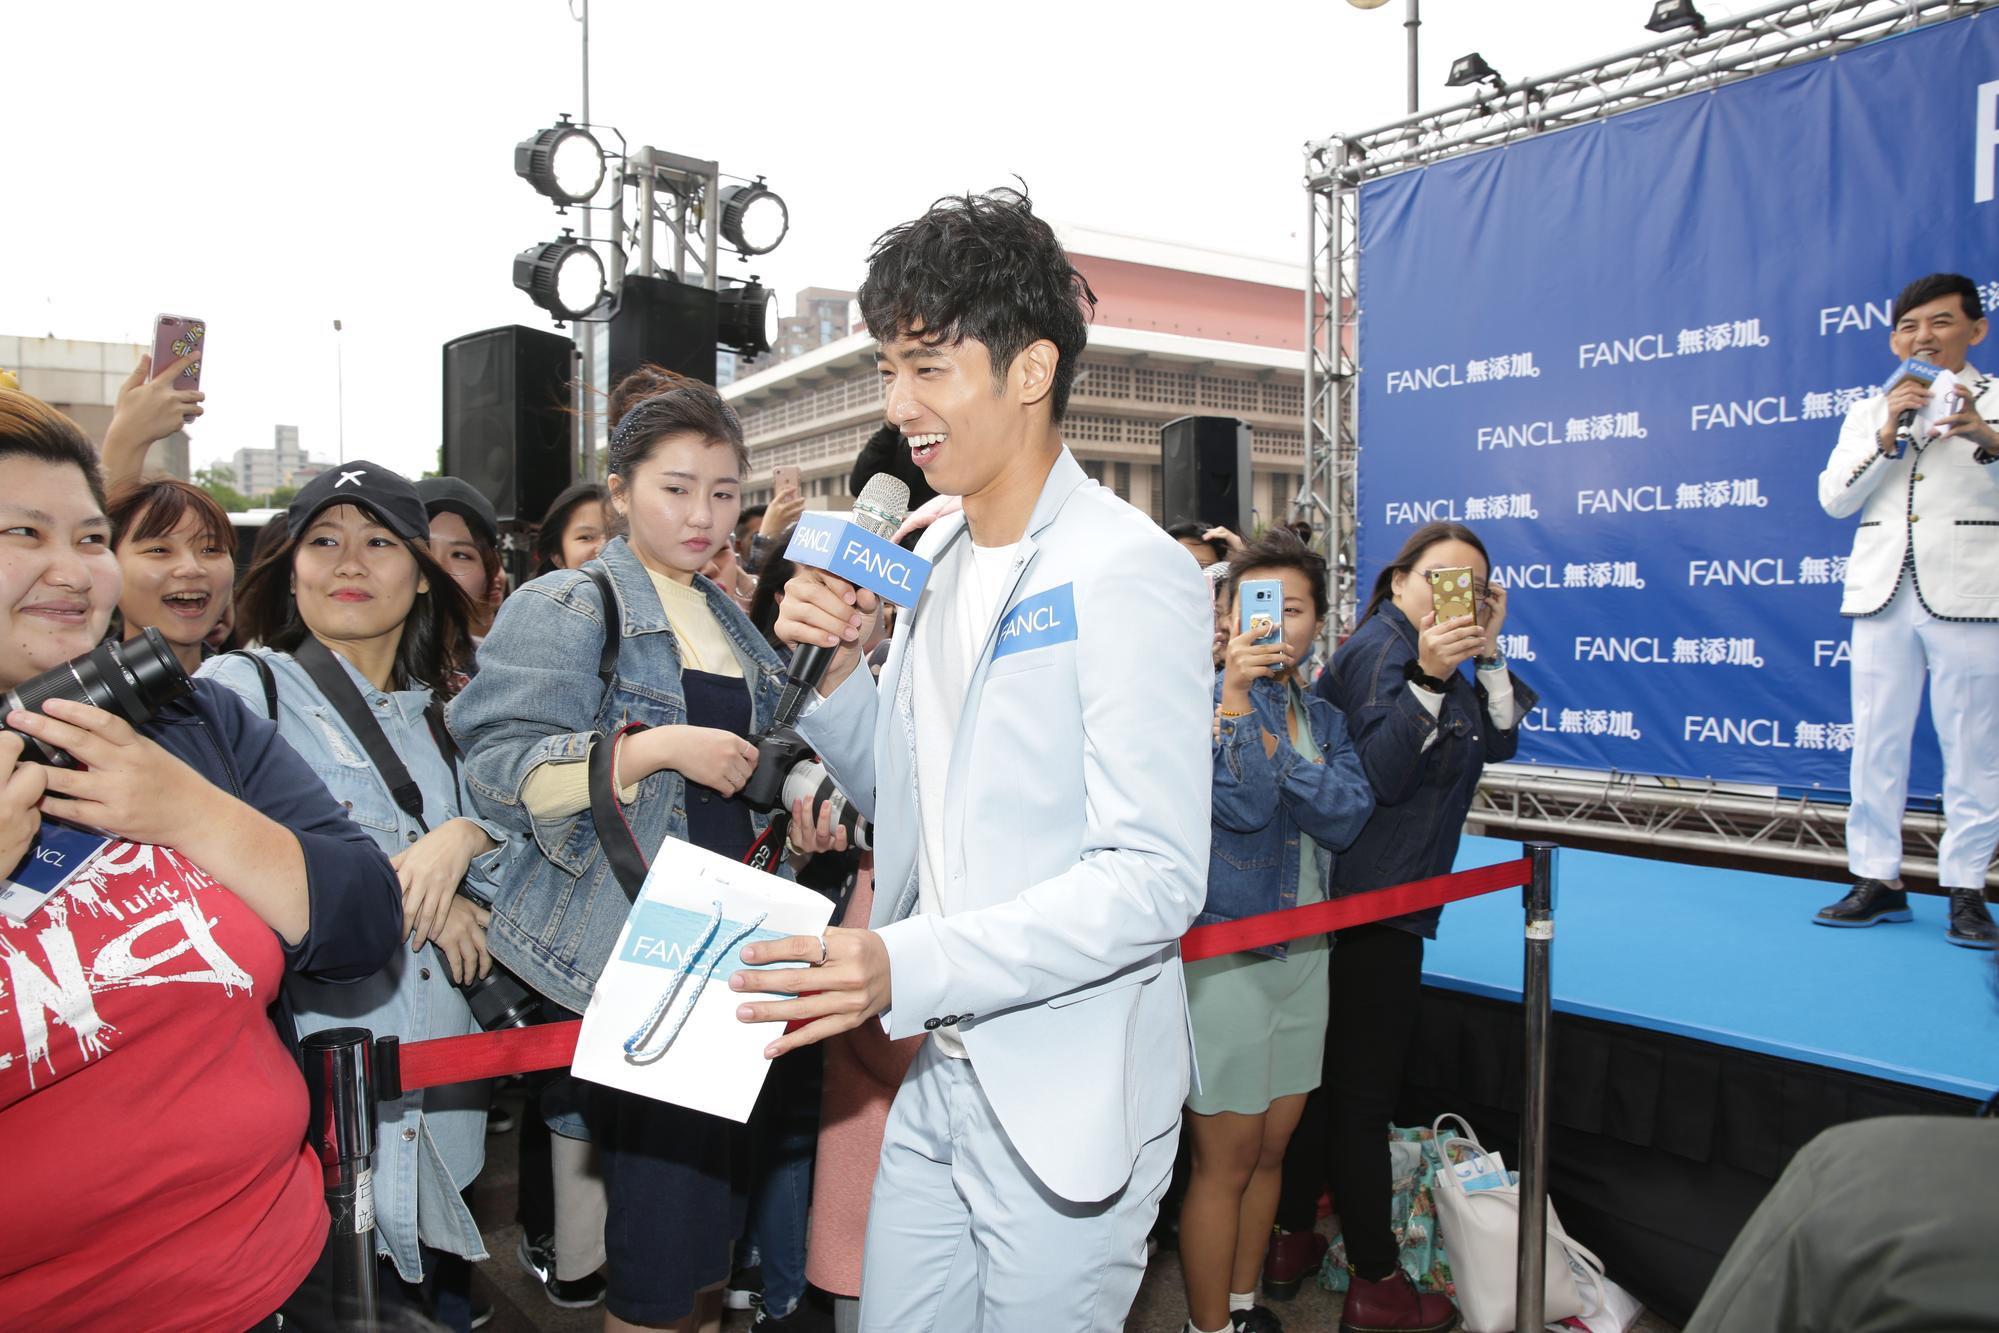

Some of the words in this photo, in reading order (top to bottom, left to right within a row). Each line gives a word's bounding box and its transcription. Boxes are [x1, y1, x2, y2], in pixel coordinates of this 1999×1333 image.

[1820, 299, 1893, 336] FAN
[1579, 334, 1674, 369] FANCL
[1387, 362, 1464, 394] FANCL
[1691, 396, 1798, 431] FANCL
[1477, 421, 1563, 451] FANCL
[1386, 499, 1463, 525] FANCL
[1577, 486, 1672, 514] FANCL
[793, 526, 832, 553] FANCL
[842, 539, 912, 592] FANCL
[1490, 564, 1561, 588] ANCL
[1688, 558, 1795, 586] FANCL
[1575, 637, 1669, 663] FANCL
[1684, 716, 1790, 748] FANCL
[33, 845, 66, 867] NCL
[632, 935, 721, 974] FAN
